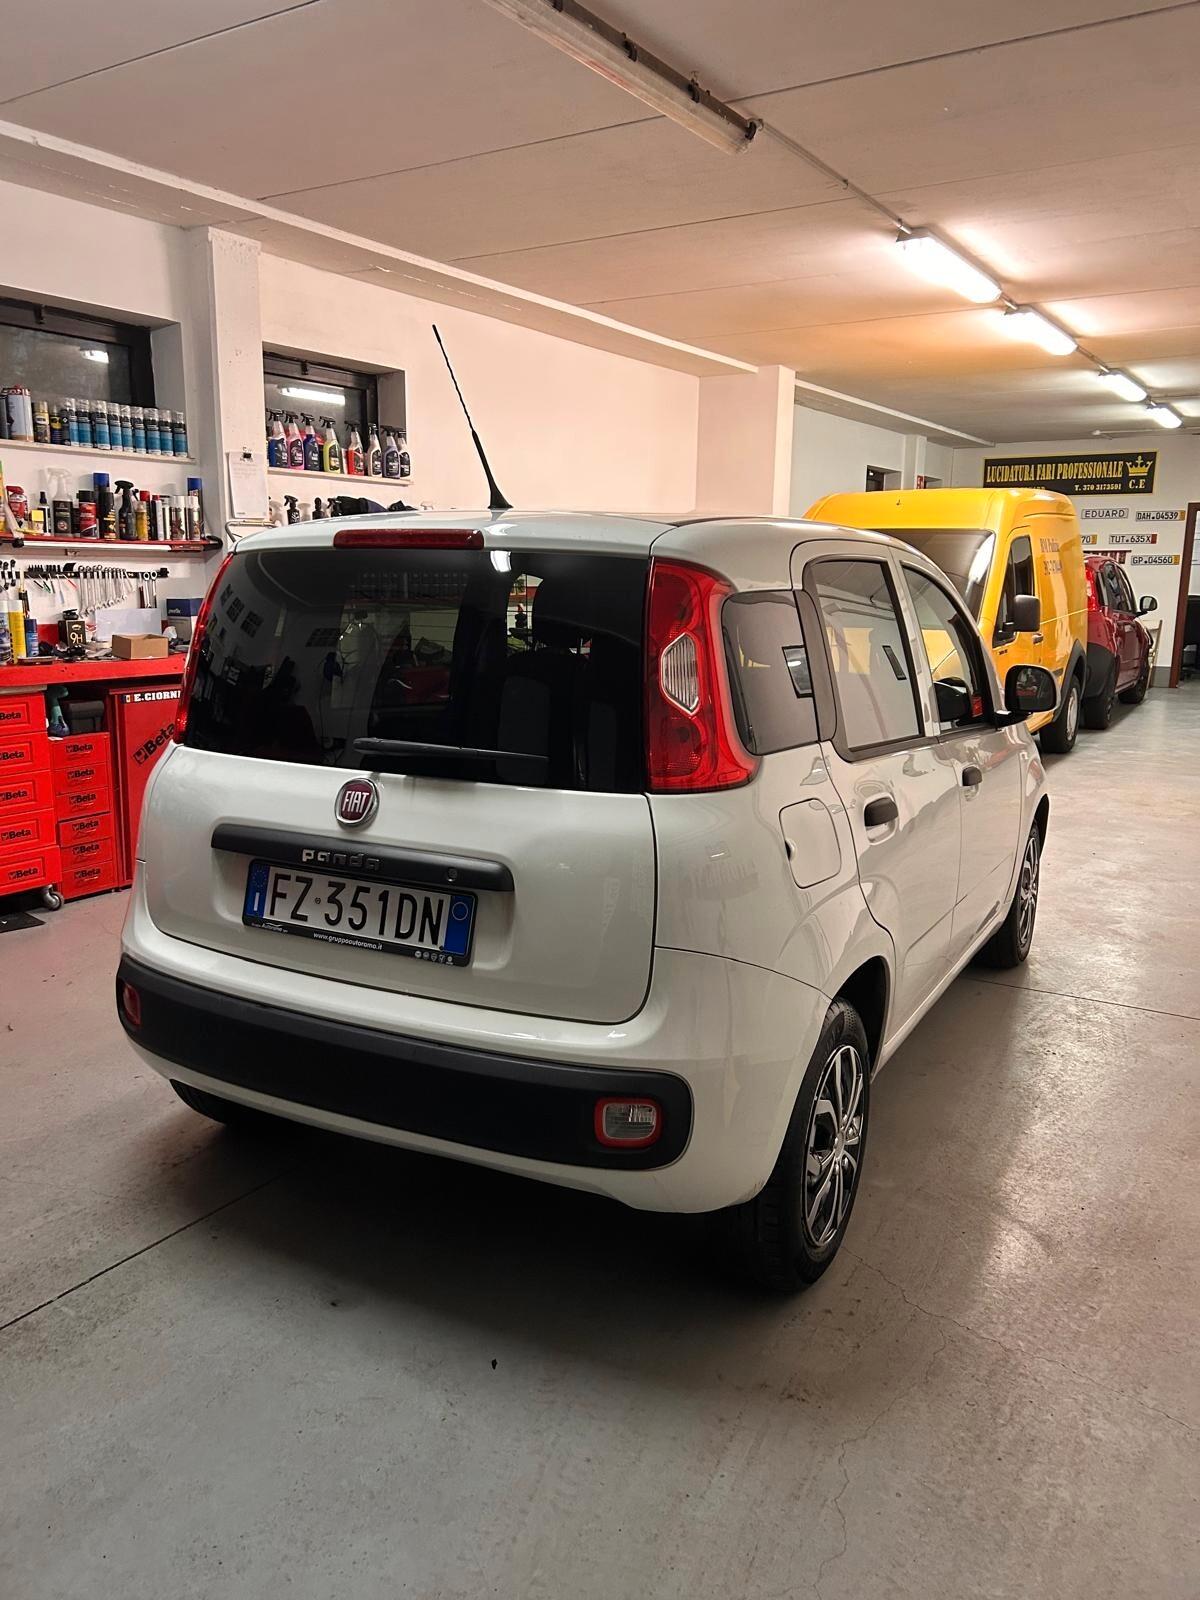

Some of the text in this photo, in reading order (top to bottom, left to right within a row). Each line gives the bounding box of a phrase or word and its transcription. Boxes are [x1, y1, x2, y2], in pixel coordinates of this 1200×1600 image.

[986, 461, 1124, 482] LUCIDATURA FARI PROFESSIONALE
[1128, 479, 1146, 489] C.E
[1084, 509, 1125, 518] EDUARD
[70, 632, 83, 644] 9H
[144, 723, 175, 757] Beta
[74, 744, 93, 752] Beta
[3, 750, 24, 760] Beta
[74, 769, 94, 777] Beta
[5, 790, 28, 800] Beta
[76, 793, 96, 802] Beta
[342, 790, 370, 813] FIAT
[80, 820, 99, 829] Beta
[9, 829, 31, 839] Beta
[80, 844, 99, 853] Beta
[16, 867, 38, 877] Beta
[81, 868, 101, 877] Beta
[269, 872, 444, 945] FZ 351DN
